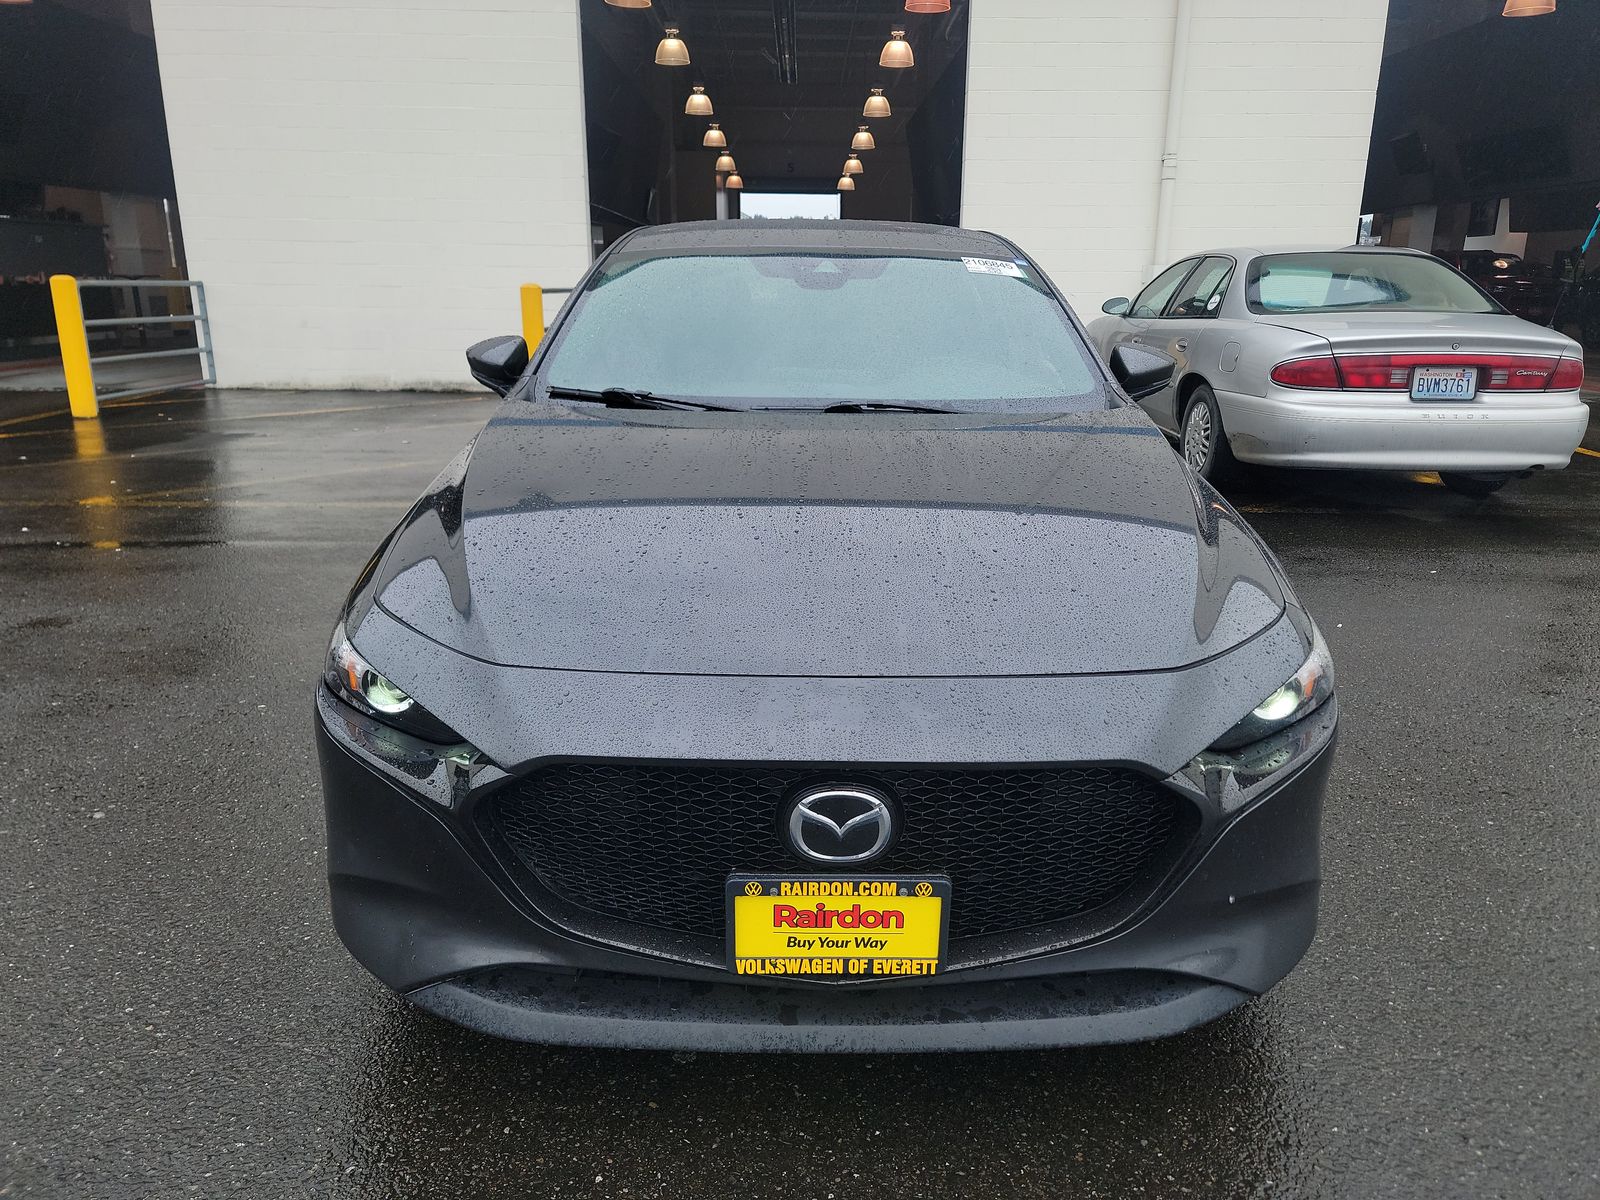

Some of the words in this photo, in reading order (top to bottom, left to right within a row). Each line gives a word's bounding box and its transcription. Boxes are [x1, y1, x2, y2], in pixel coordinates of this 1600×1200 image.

[1516, 369, 1548, 377] Century
[1417, 378, 1470, 393] BVM3761
[780, 882, 897, 897] RAIRDON.COM
[773, 903, 904, 929] Rairdon
[786, 937, 815, 950] Buy
[818, 937, 851, 949] Your
[854, 937, 888, 950] Way
[735, 959, 843, 975] VOLKSWAGEN
[849, 959, 868, 974] OF
[873, 959, 938, 975] EVERETT
